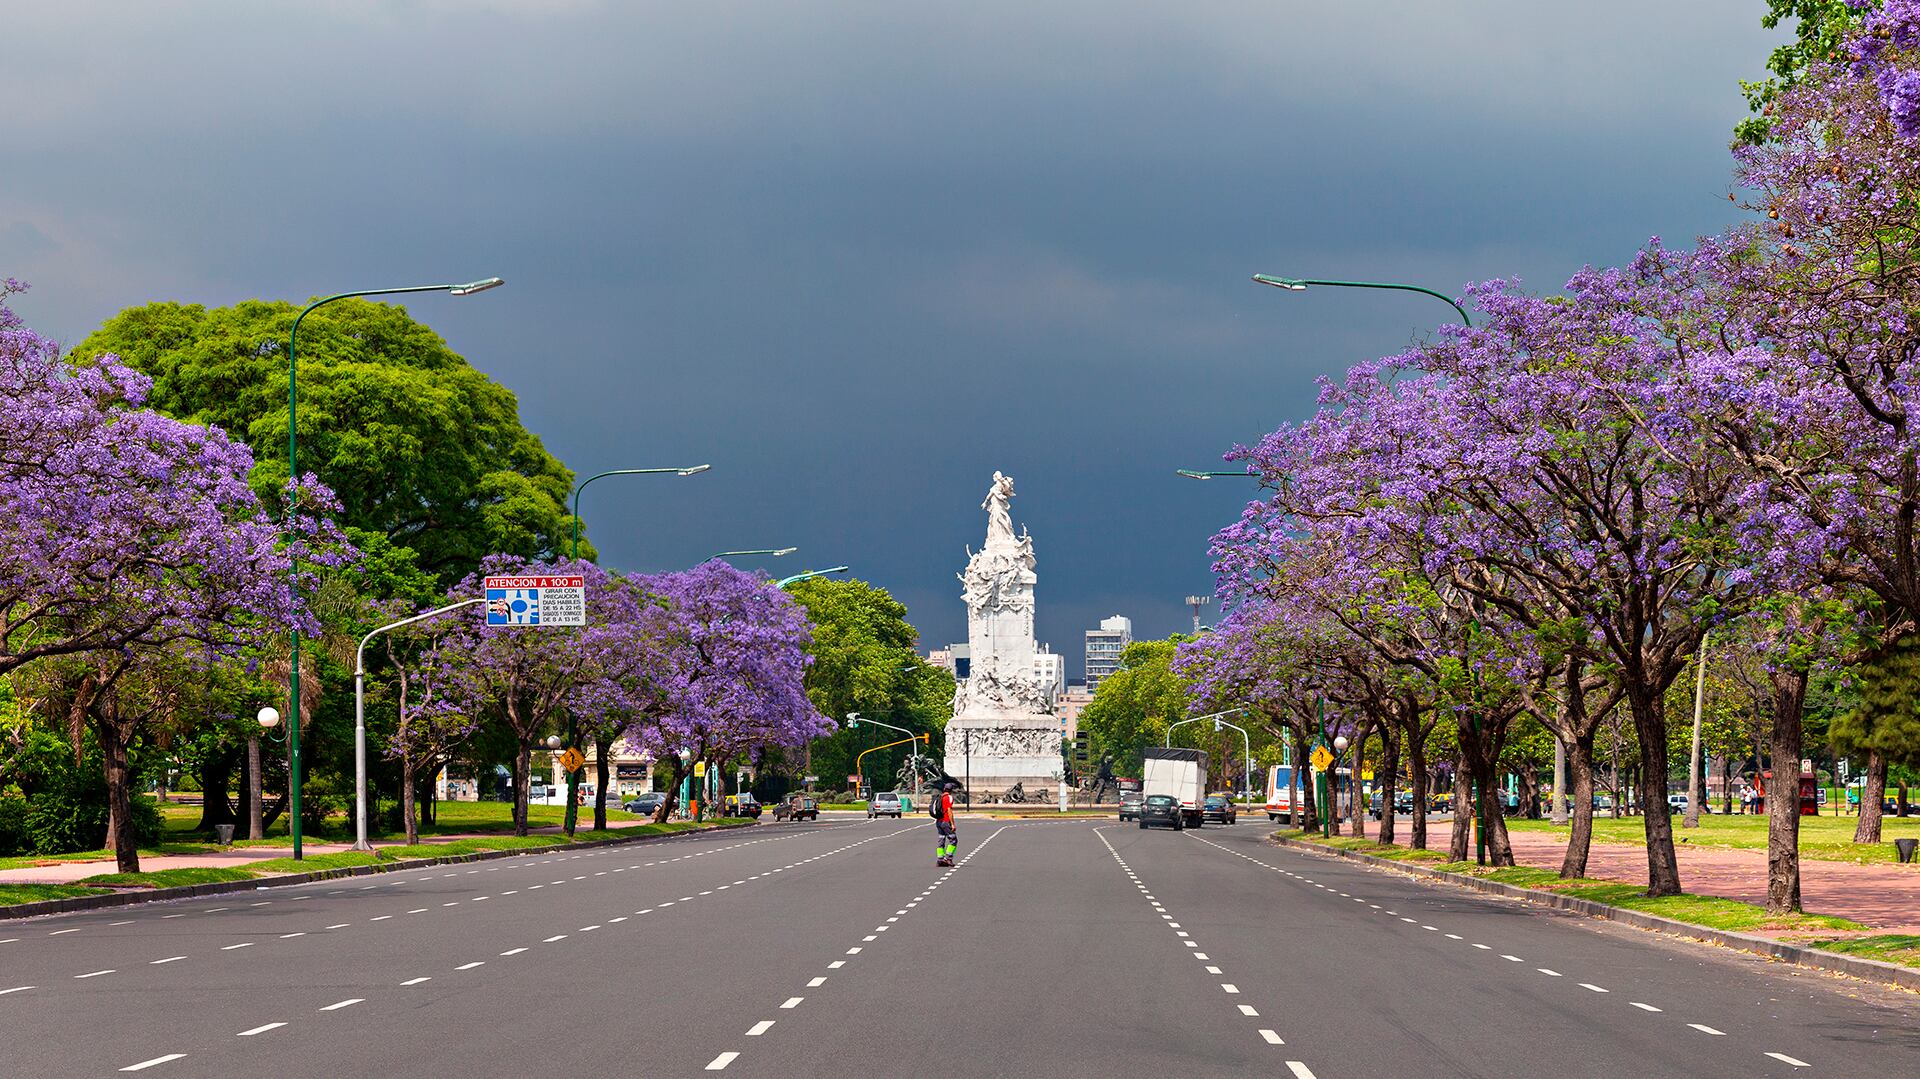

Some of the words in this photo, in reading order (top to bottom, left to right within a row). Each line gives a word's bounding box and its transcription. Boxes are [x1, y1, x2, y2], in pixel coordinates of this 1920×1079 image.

[488, 578, 536, 587] ATENCION
[540, 578, 548, 587] A
[551, 578, 568, 587] 100
